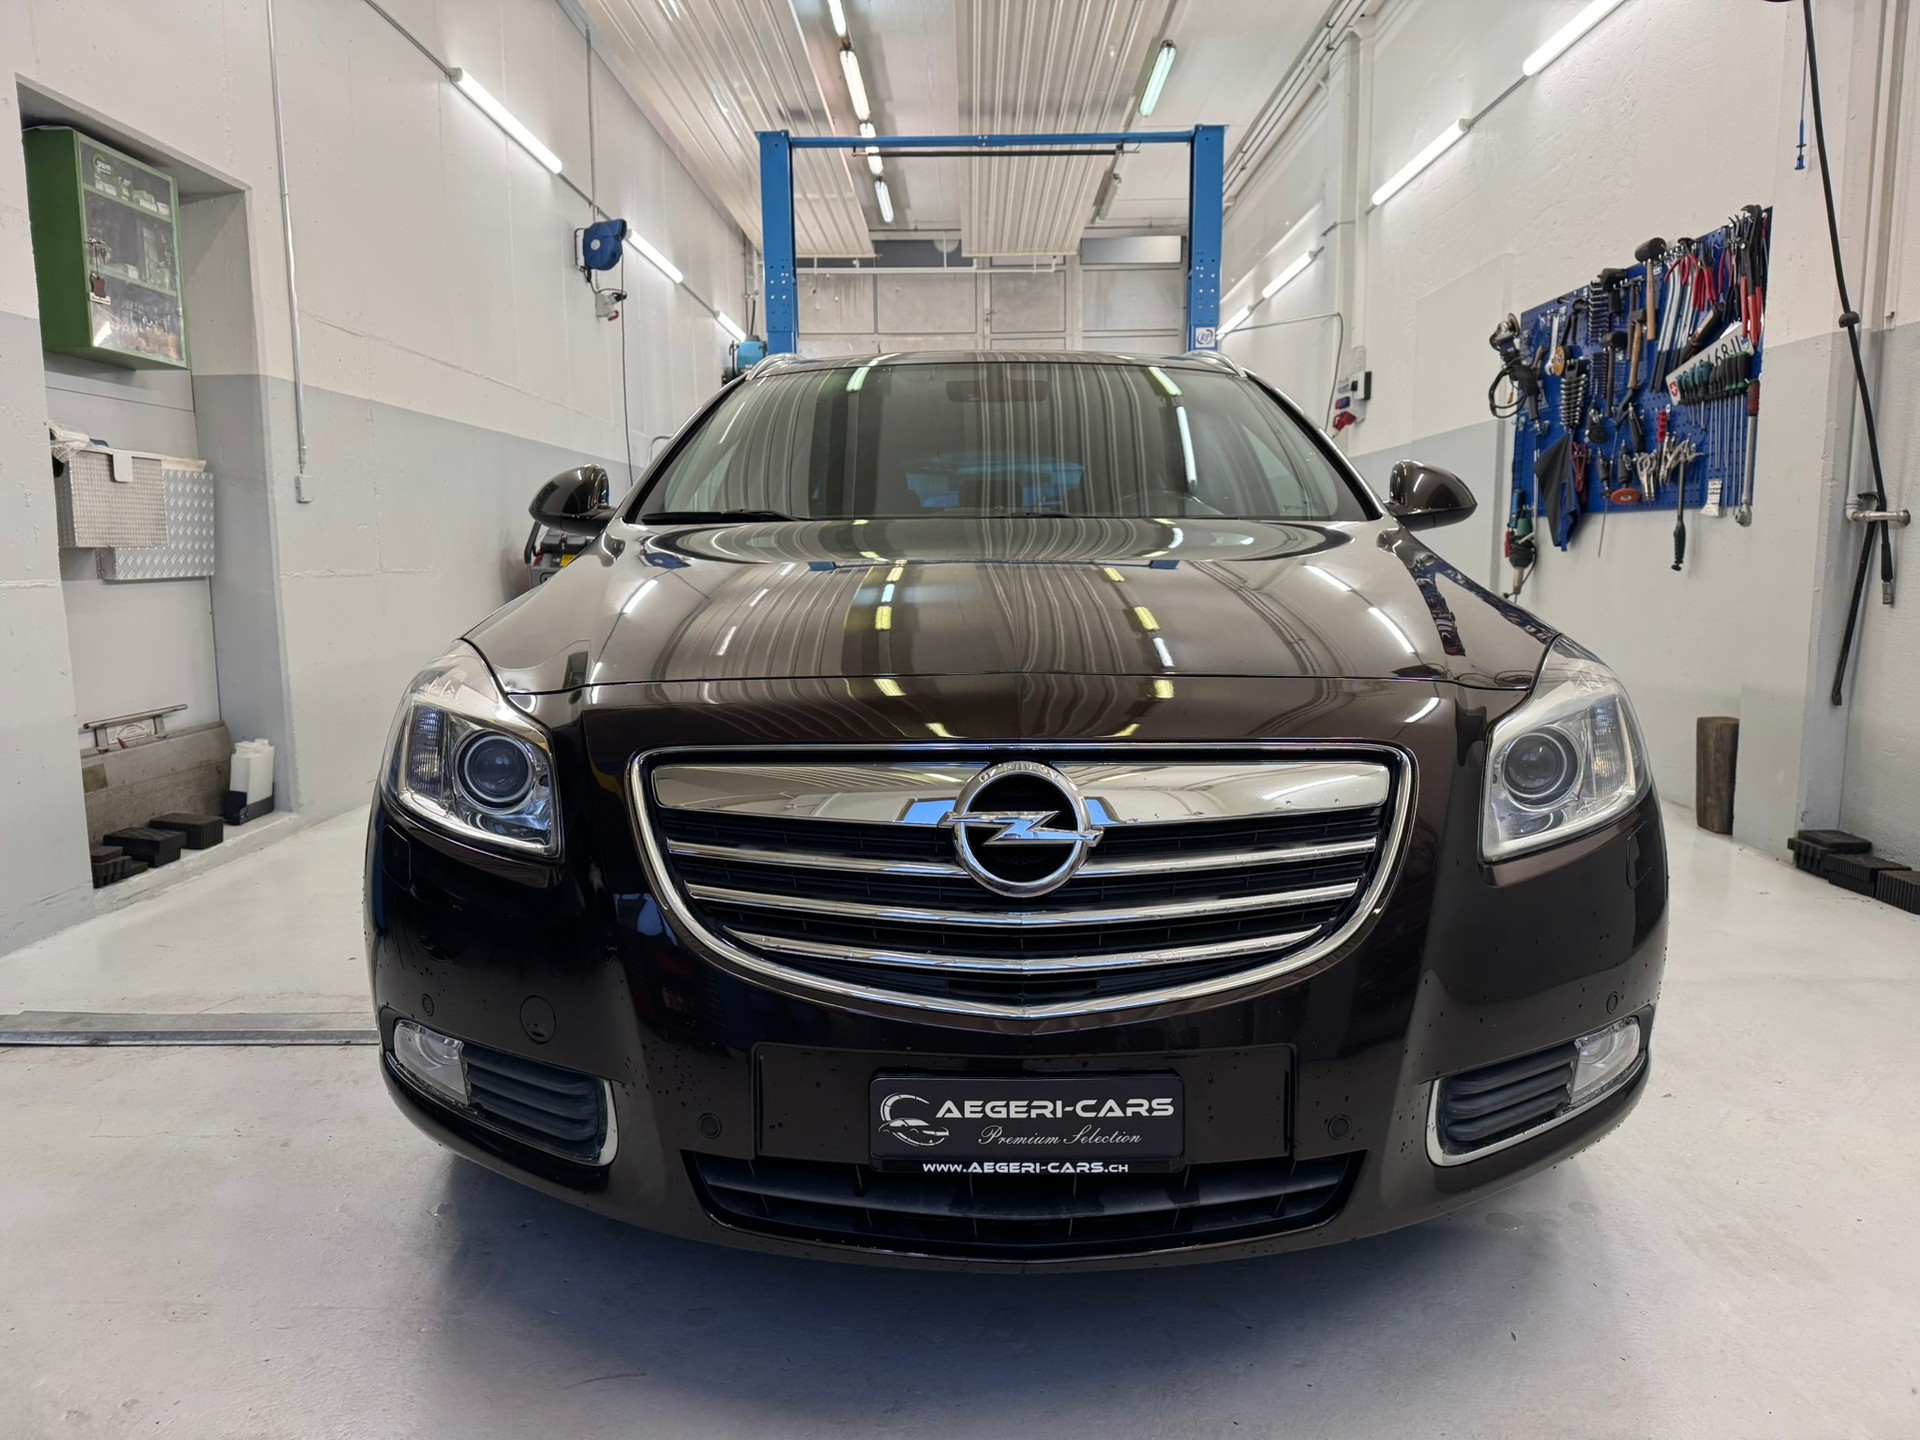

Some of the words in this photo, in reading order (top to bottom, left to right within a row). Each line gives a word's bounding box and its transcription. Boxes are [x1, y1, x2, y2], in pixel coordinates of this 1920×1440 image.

[935, 1098, 1175, 1118] AEGERI-CARS
[977, 1125, 1061, 1145] Premium
[1063, 1124, 1142, 1144] Selection
